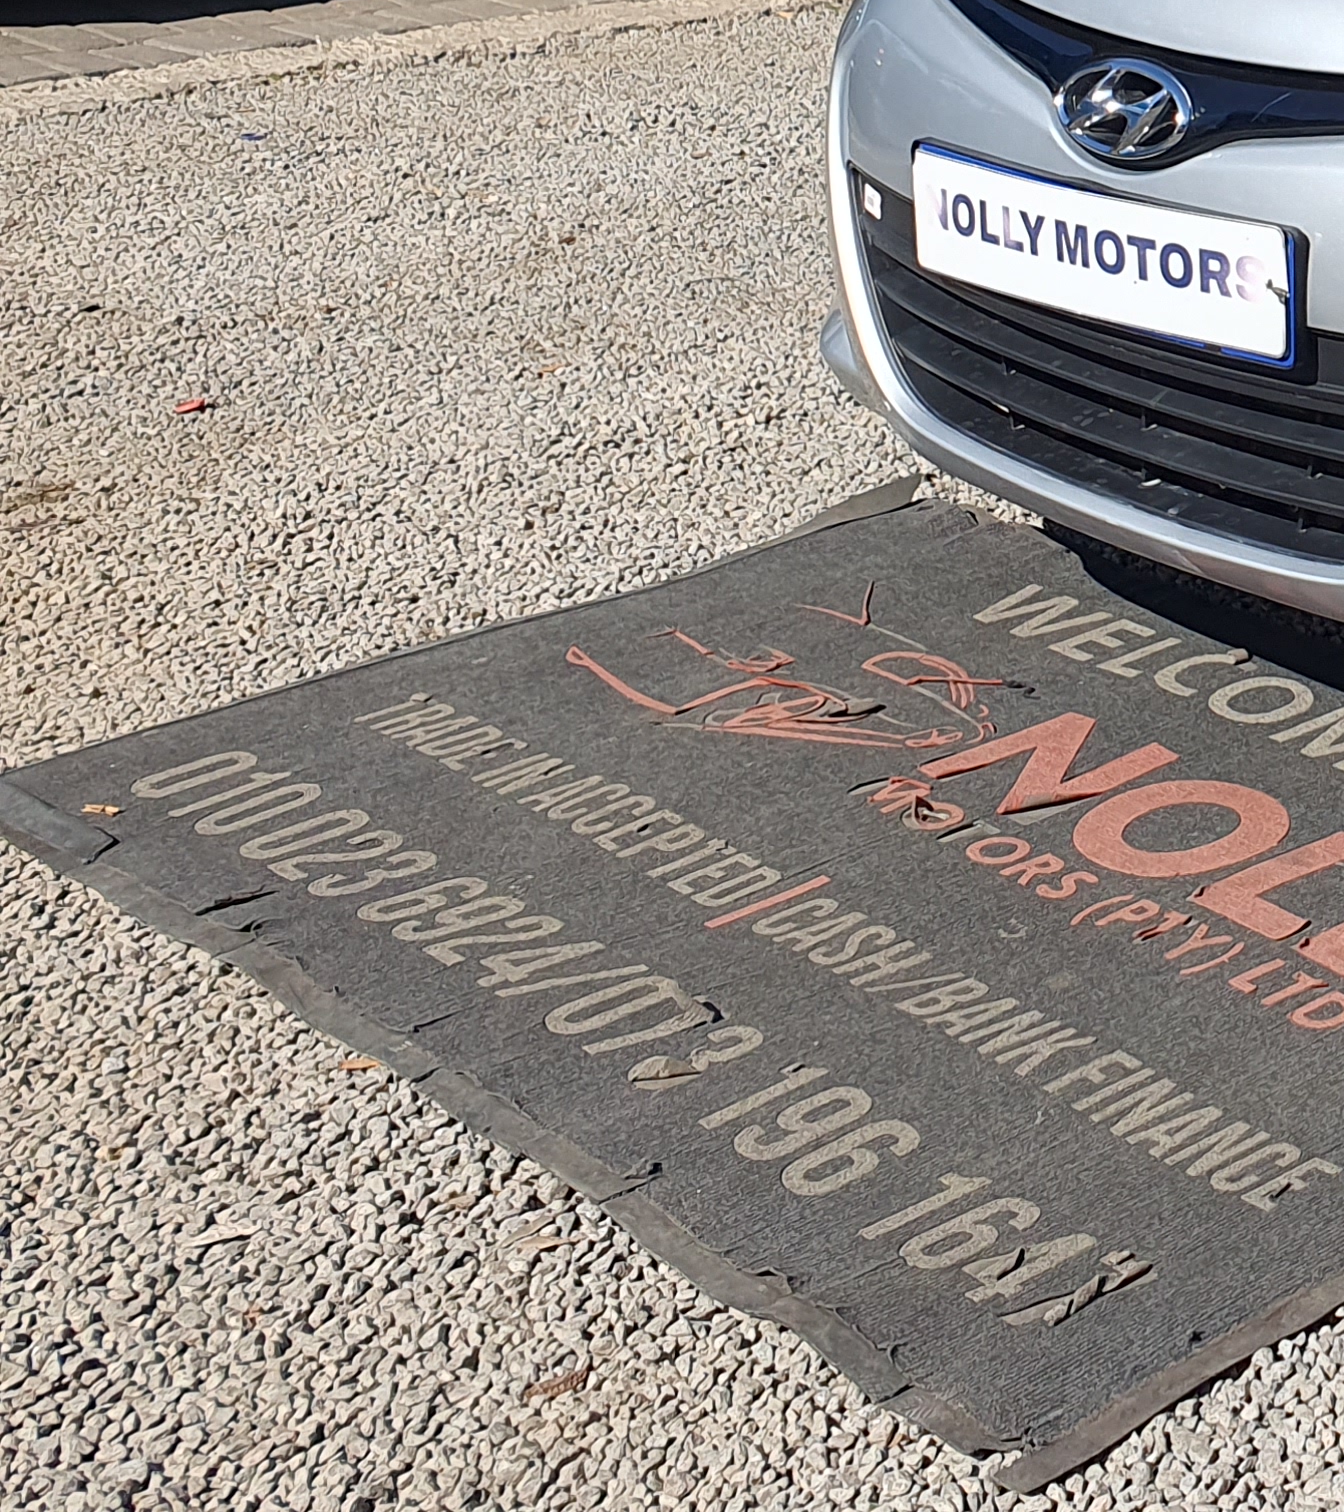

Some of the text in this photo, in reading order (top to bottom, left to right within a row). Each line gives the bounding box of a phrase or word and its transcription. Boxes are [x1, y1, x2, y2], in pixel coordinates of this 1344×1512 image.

[1055, 218, 1266, 303] MOTORS
[131, 750, 322, 834] 010
[238, 808, 438, 896] 023
[699, 1063, 920, 1195] 196
[352, 692, 527, 770] TRADE
[470, 752, 576, 794] IN
[1043, 1051, 1340, 1210] FINANCE
[1073, 896, 1242, 972] (PTY)
